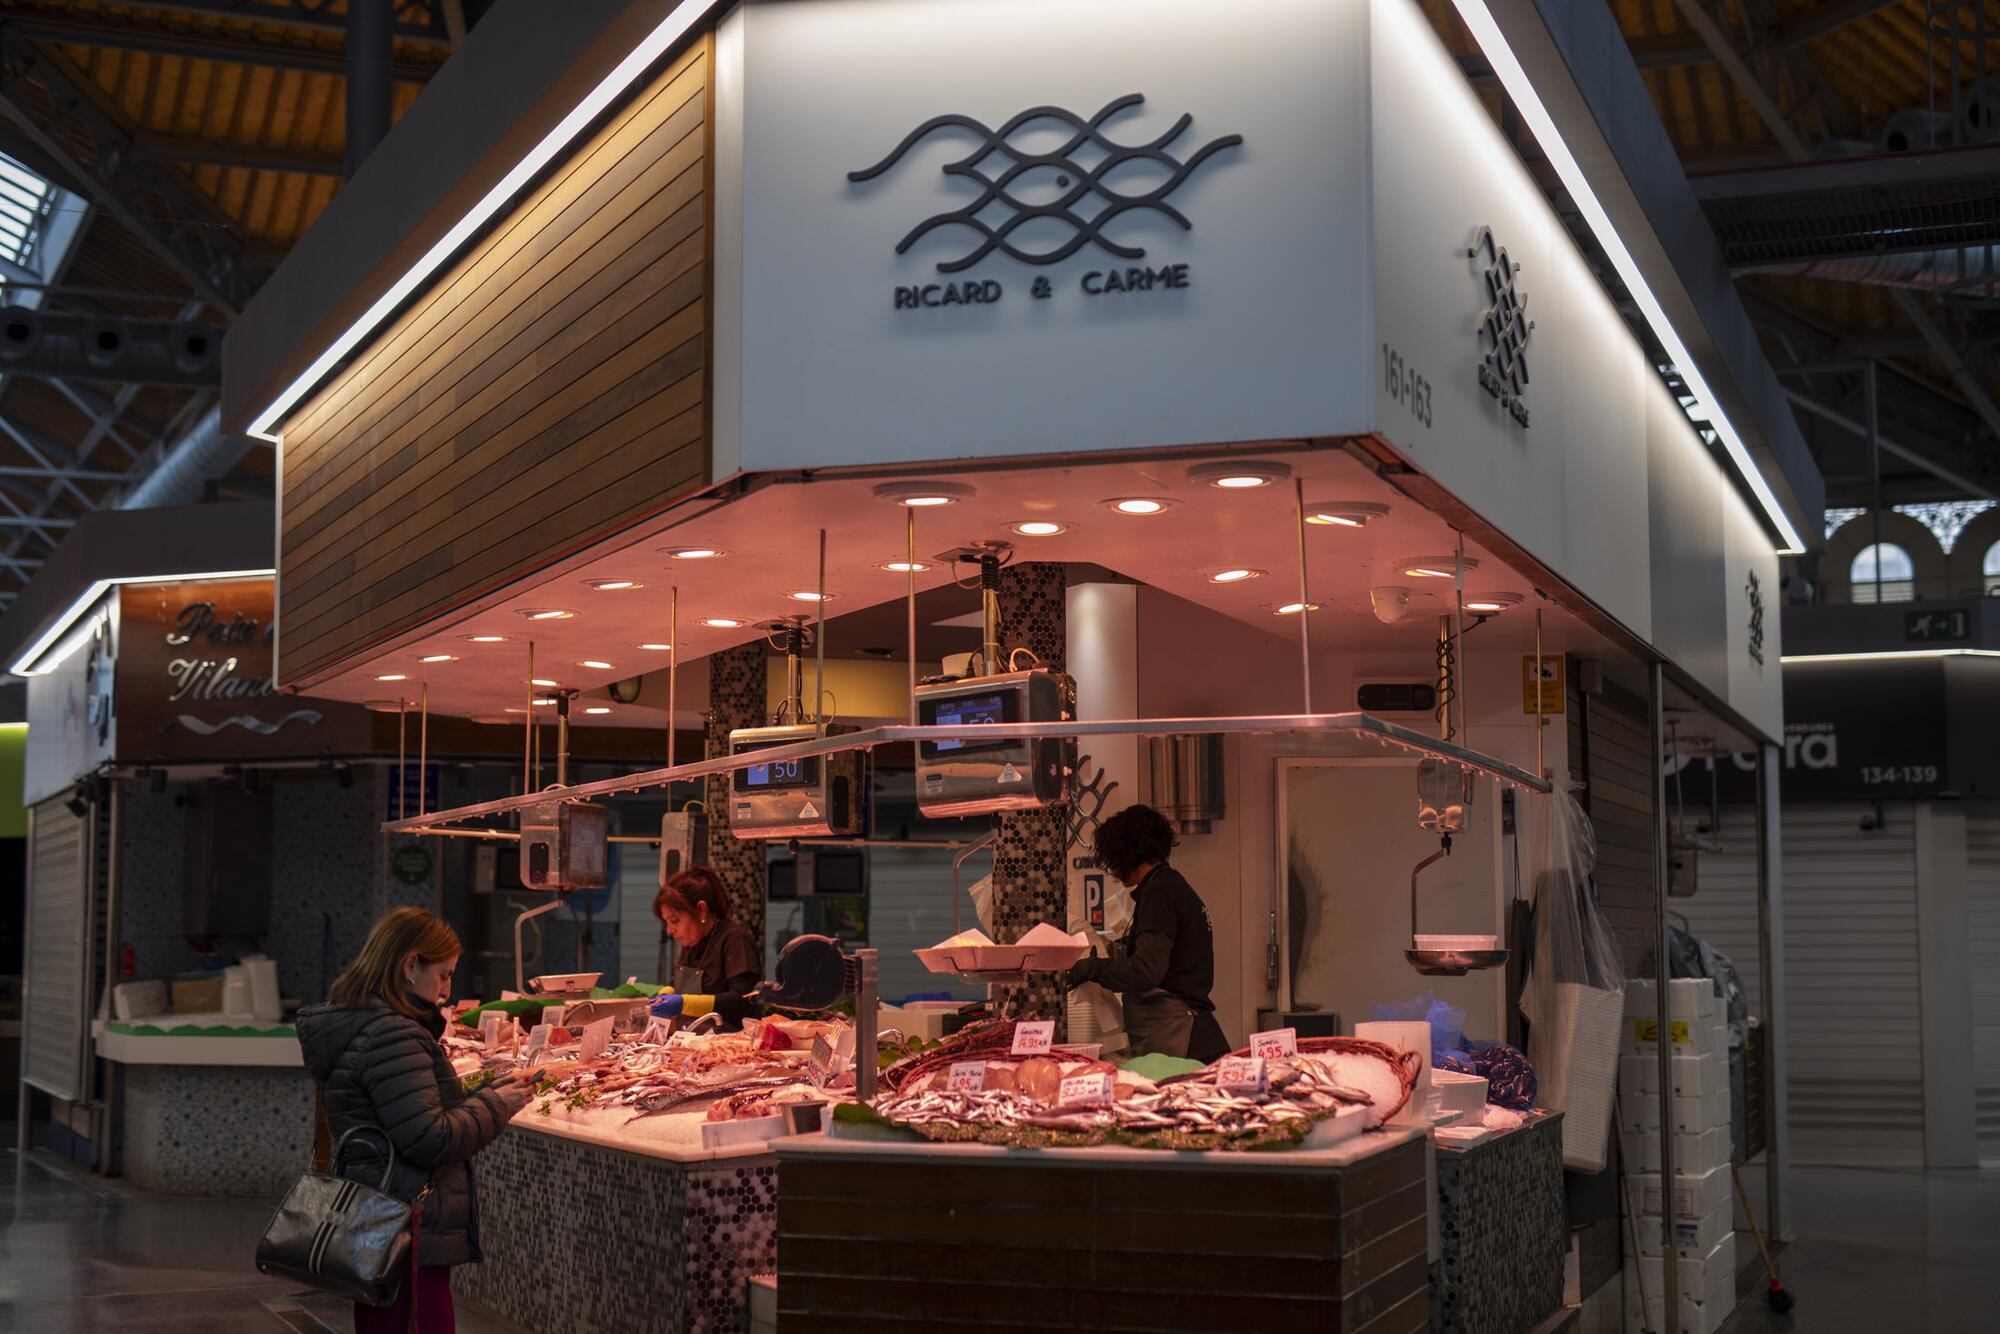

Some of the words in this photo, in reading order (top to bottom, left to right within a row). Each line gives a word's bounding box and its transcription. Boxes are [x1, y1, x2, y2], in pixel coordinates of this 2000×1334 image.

[895, 279, 1002, 309] RICARD
[1031, 275, 1052, 299] &
[1081, 264, 1189, 295] CARME
[1383, 343, 1432, 429] 161-163
[775, 759, 797, 778] 50
